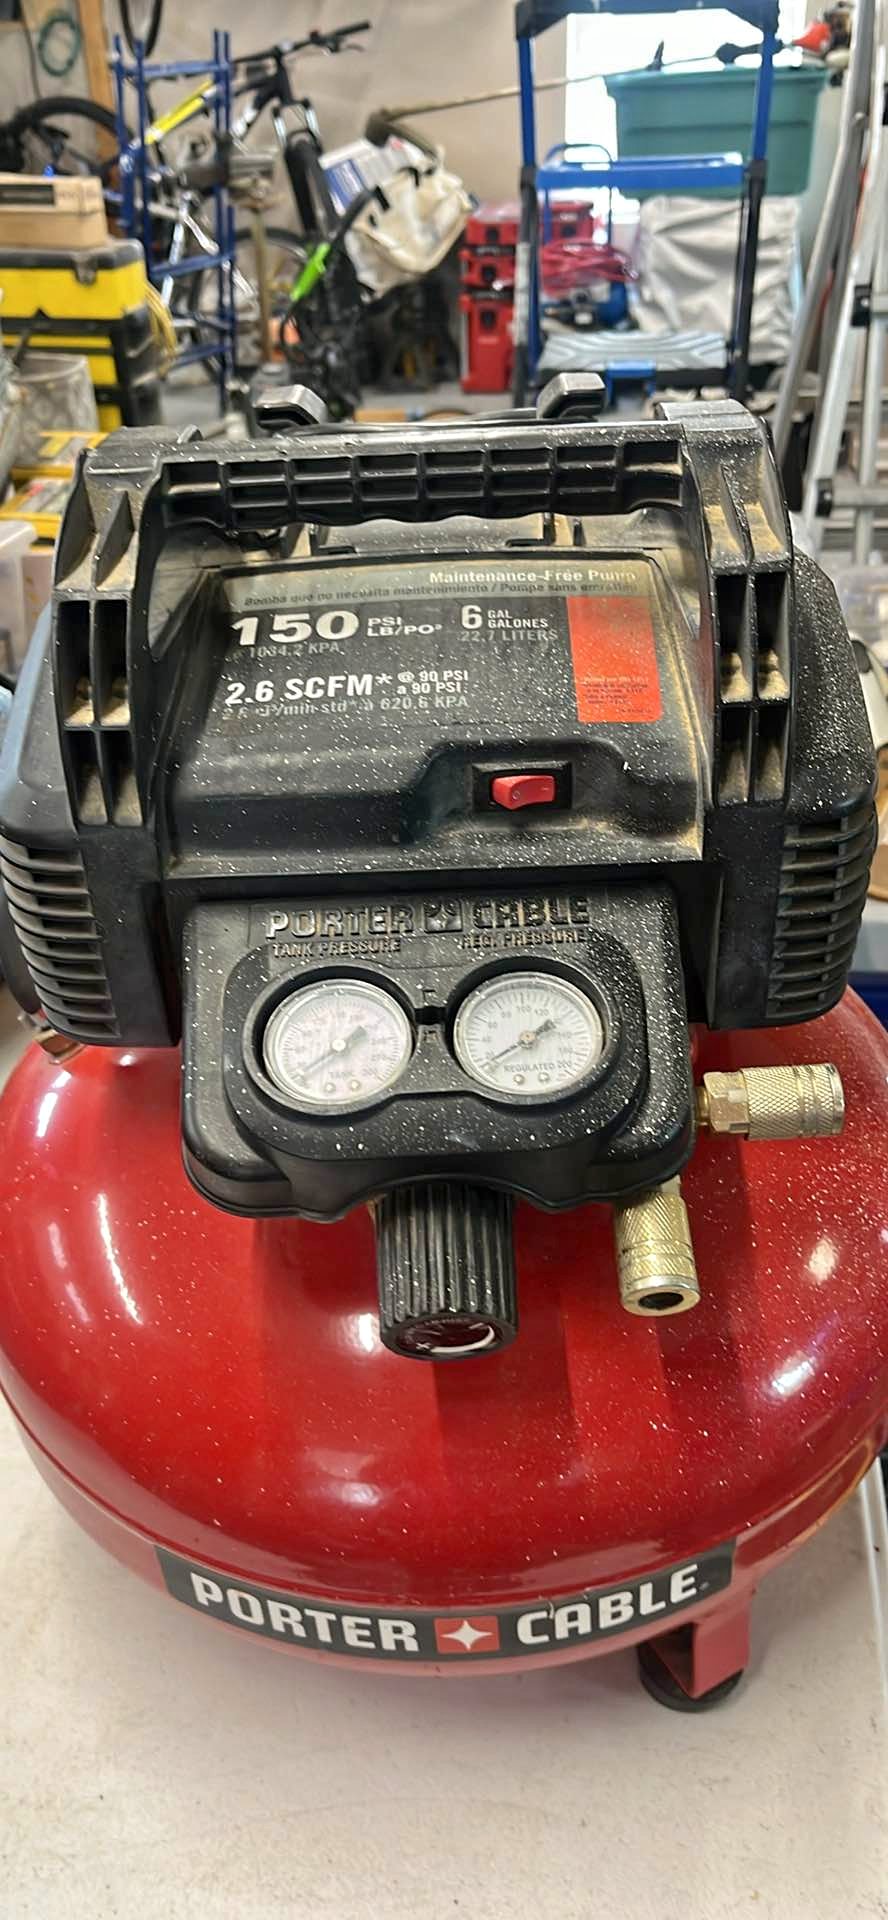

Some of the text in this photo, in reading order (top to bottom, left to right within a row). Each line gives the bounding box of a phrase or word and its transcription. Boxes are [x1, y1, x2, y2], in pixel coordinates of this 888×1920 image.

[429, 570, 583, 584] Maintenance-Free
[460, 604, 483, 630] 6
[487, 609, 513, 619] GAL
[231, 610, 359, 646] 150
[367, 616, 402, 627] PSI
[487, 617, 549, 629] GALONES
[502, 629, 558, 642] LITERS
[308, 641, 340, 654] KPA
[397, 669, 469, 683] @ 90 PSI
[224, 680, 275, 705] 2.6
[411, 682, 431, 694] 90
[435, 681, 461, 693] PSI
[434, 694, 470, 709] KPA
[266, 898, 591, 940] PORTER CABLE
[503, 929, 586, 947] PRESSURE
[273, 938, 401, 958] TANK PRESSURE
[503, 1062, 555, 1073] REGULATED
[189, 1562, 699, 1653] PORTER CABLE
